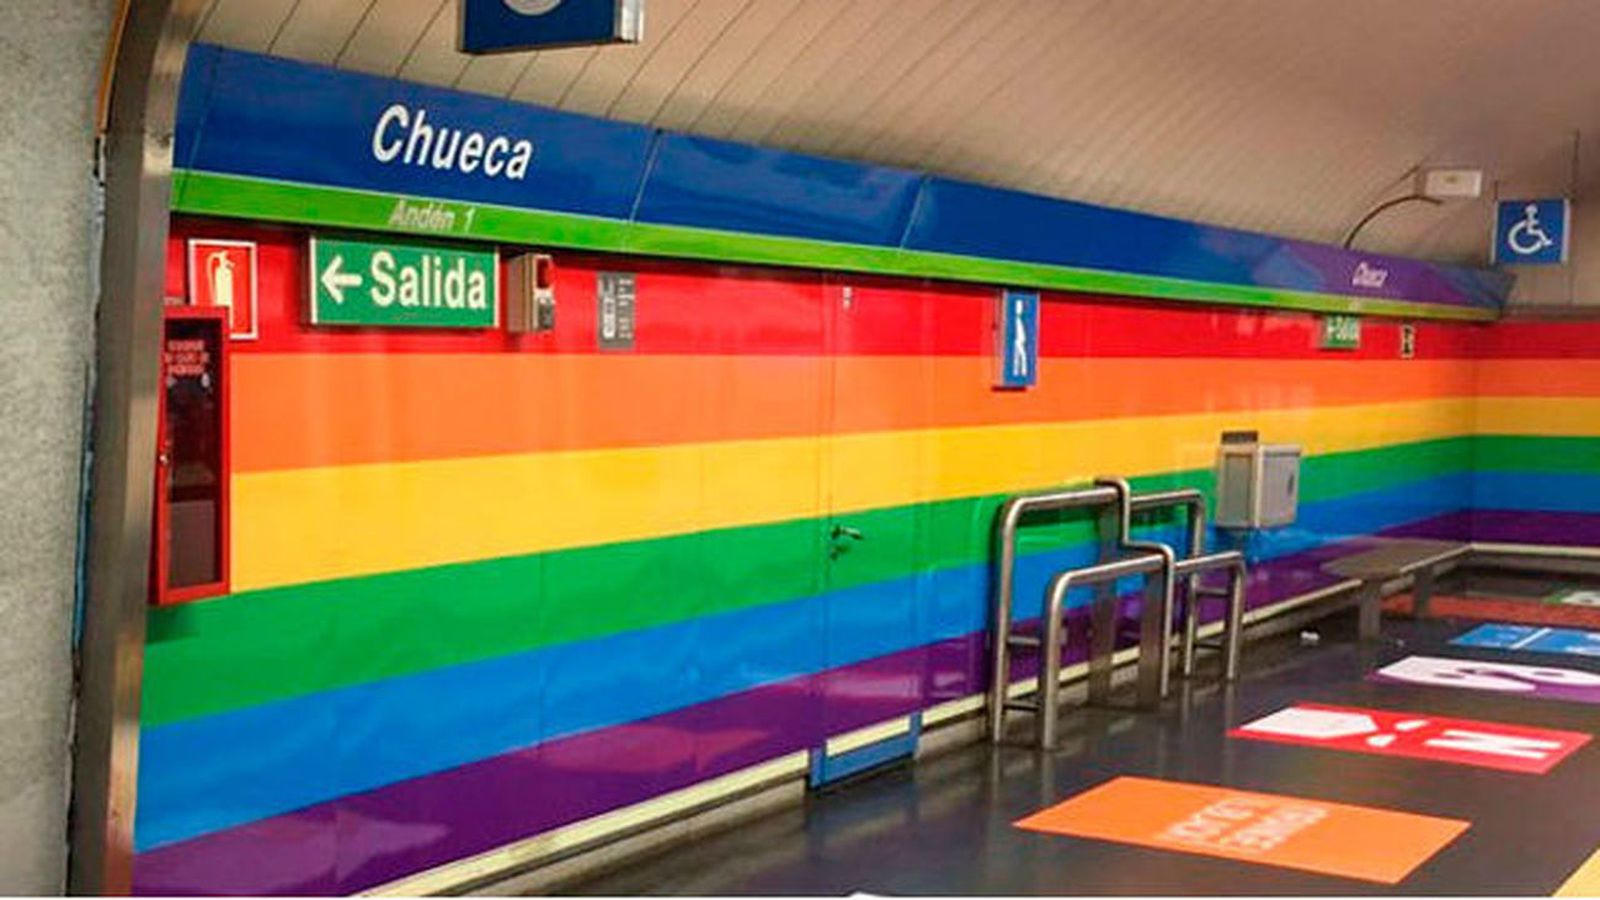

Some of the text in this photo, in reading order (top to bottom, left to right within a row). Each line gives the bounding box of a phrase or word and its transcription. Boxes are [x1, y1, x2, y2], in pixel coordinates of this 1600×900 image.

[373, 105, 533, 179] Chueca
[389, 199, 476, 233] Andén 1
[370, 250, 487, 310] Salida
